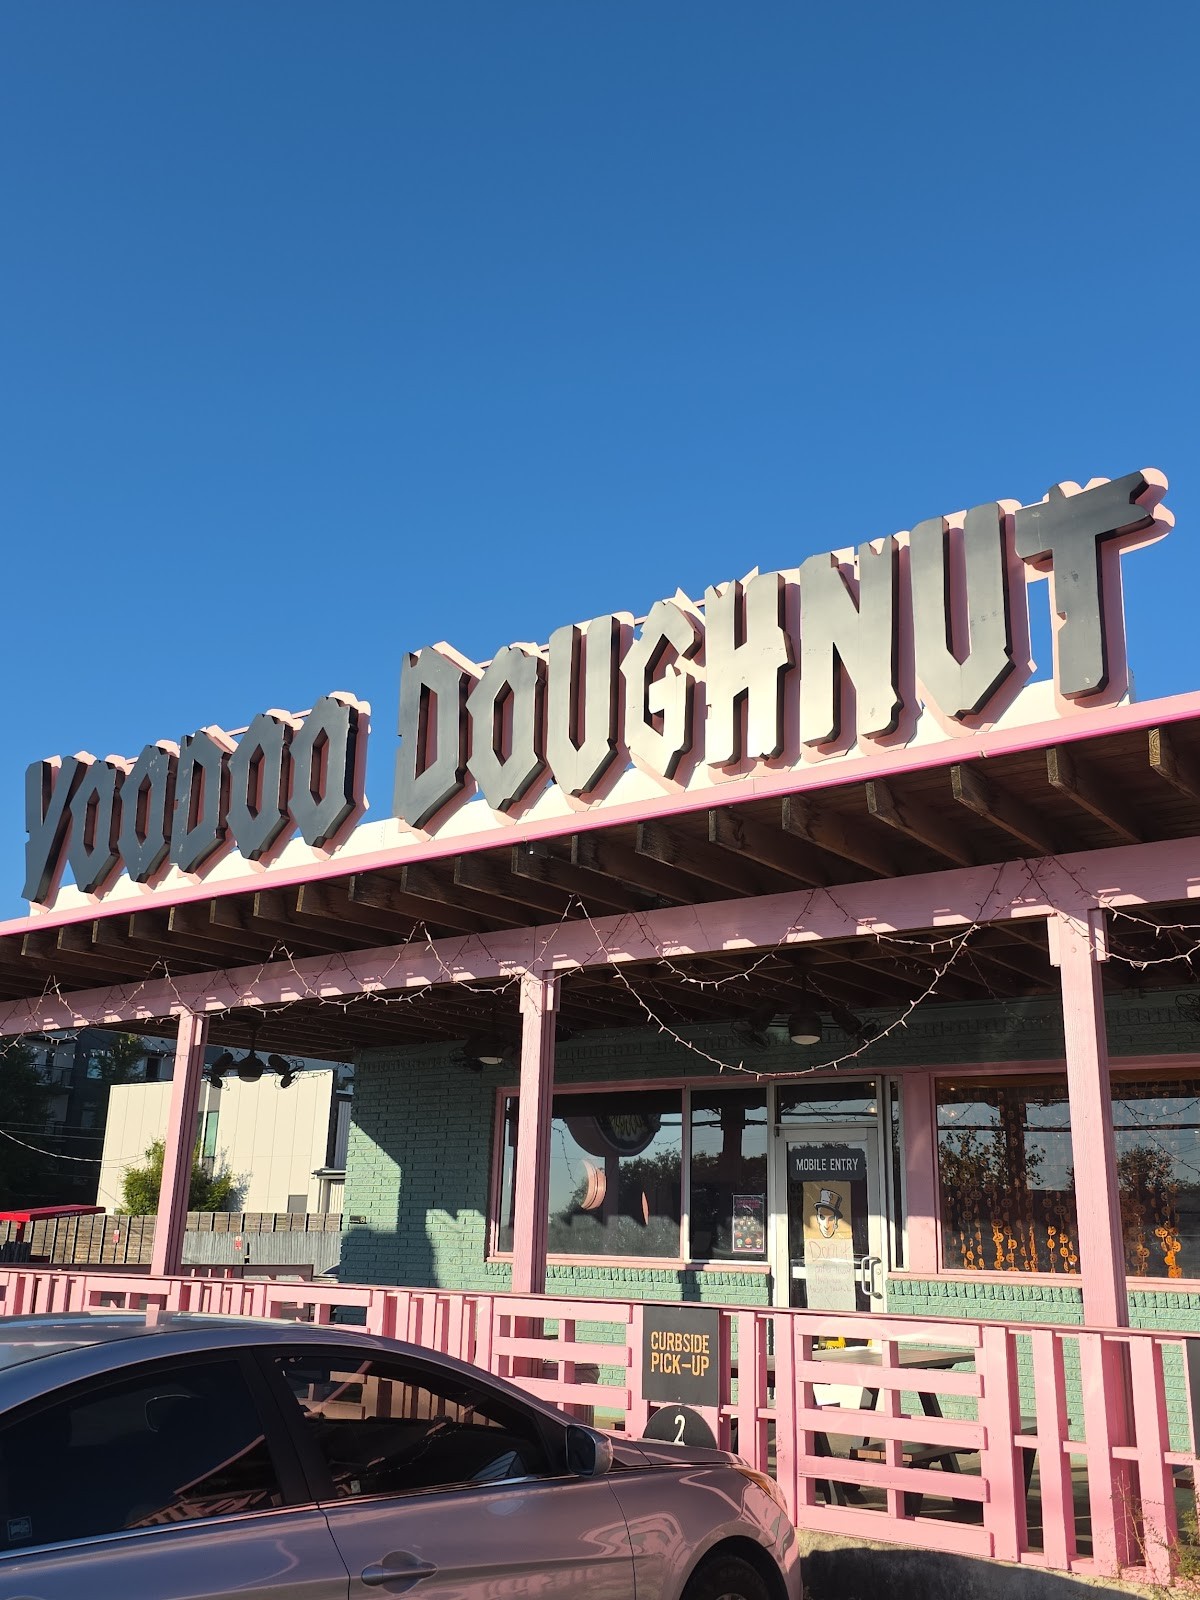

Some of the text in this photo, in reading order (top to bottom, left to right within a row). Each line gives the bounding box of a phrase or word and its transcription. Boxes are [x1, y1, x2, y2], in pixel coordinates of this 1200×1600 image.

[21, 469, 1170, 904] VOODOO DOUGHNUT
[796, 1158, 859, 1171] MOBILE ENTRY
[650, 1331, 710, 1354] CURBSIDE
[650, 1352, 710, 1377] PICK-UP
[673, 1414, 686, 1446] 2
